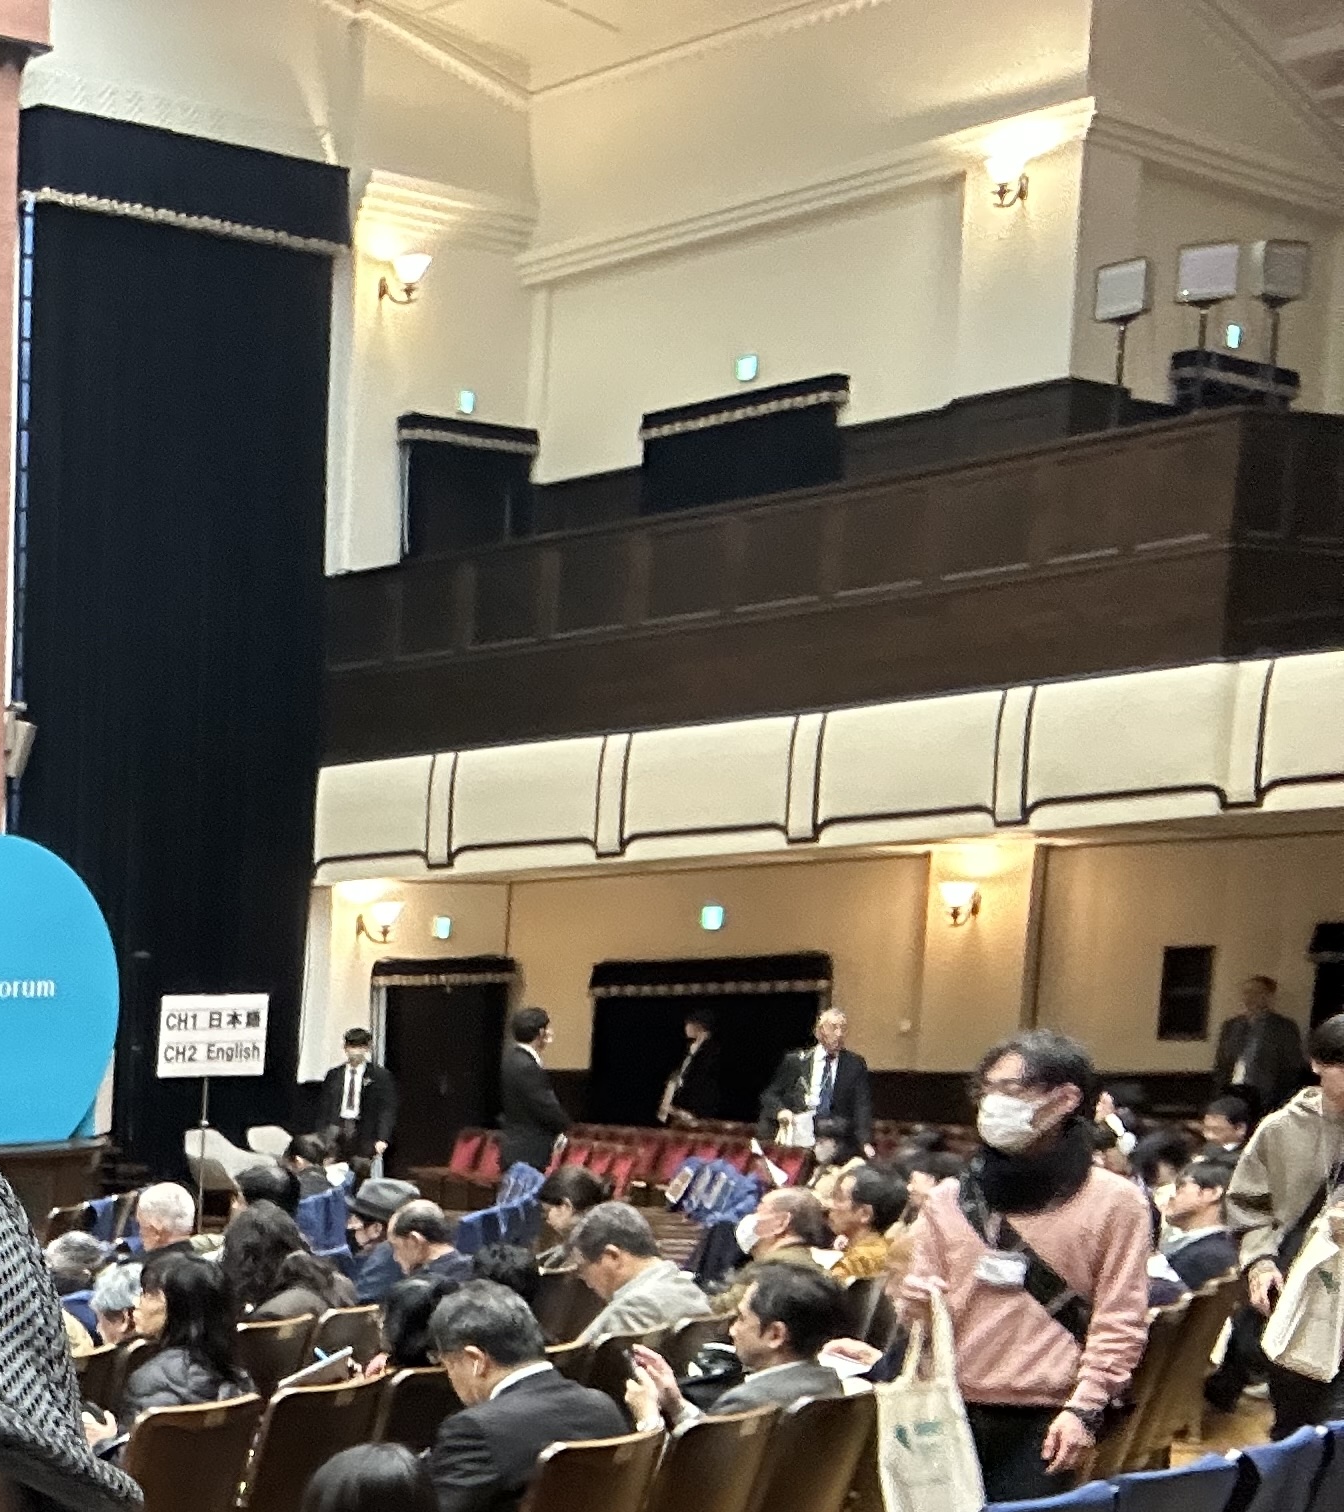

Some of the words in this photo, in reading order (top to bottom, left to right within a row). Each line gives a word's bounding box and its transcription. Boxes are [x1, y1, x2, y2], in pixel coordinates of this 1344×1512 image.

[166, 1012, 197, 1031] CH1
[164, 1044, 197, 1063] CH2
[206, 1042, 260, 1063] English
